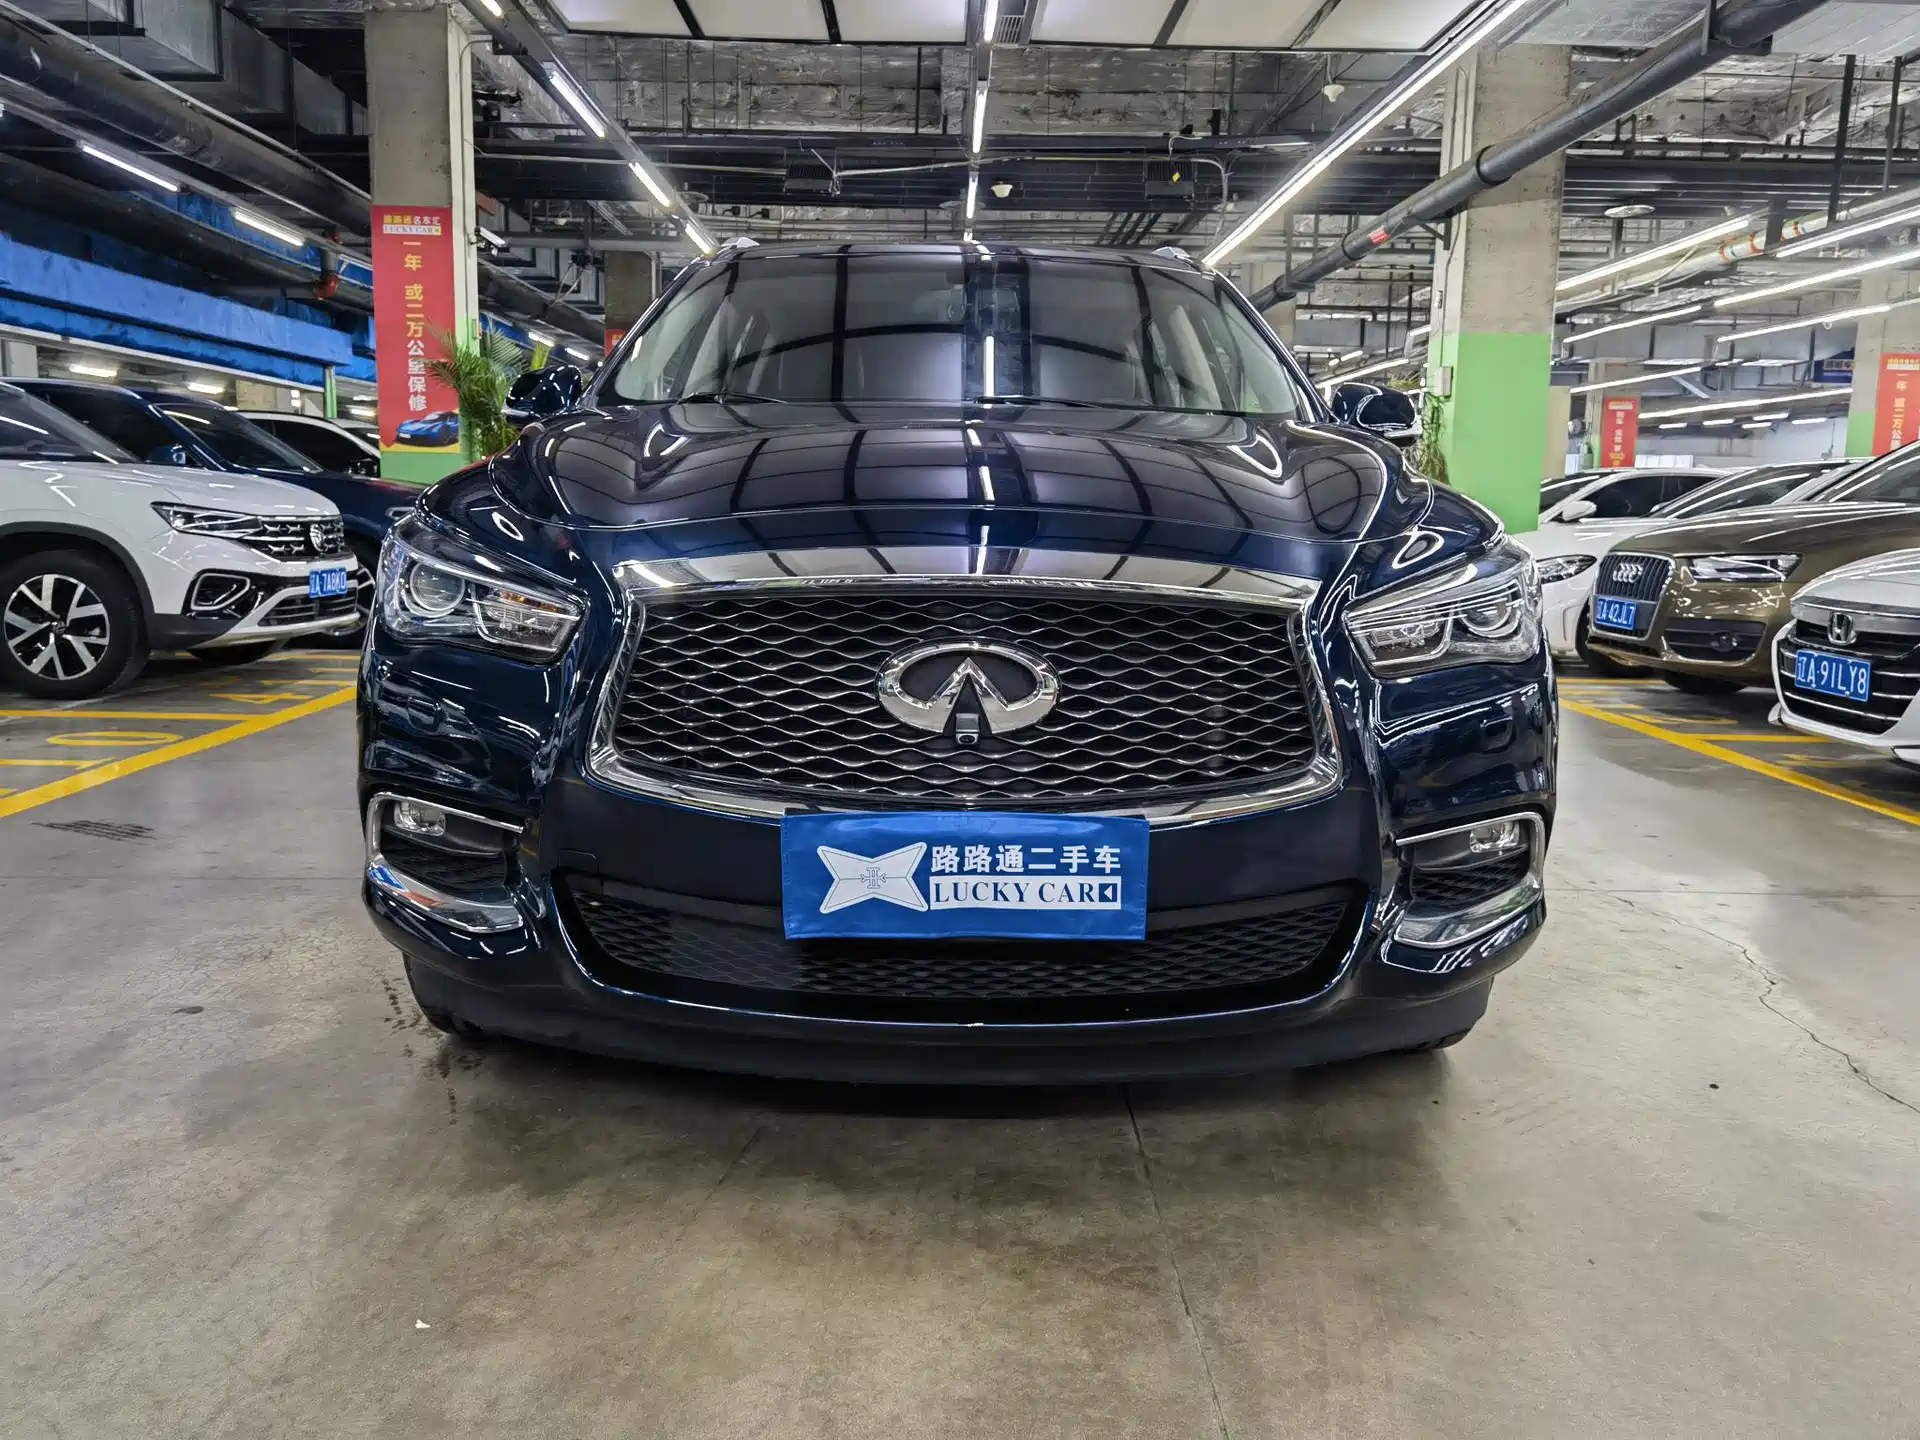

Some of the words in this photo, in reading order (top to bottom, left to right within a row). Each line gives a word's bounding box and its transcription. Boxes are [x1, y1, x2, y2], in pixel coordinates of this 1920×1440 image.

[930, 844, 1121, 873] 路路通二手车
[934, 881, 1029, 903] LUCKY
[1038, 881, 1095, 903] CAR
